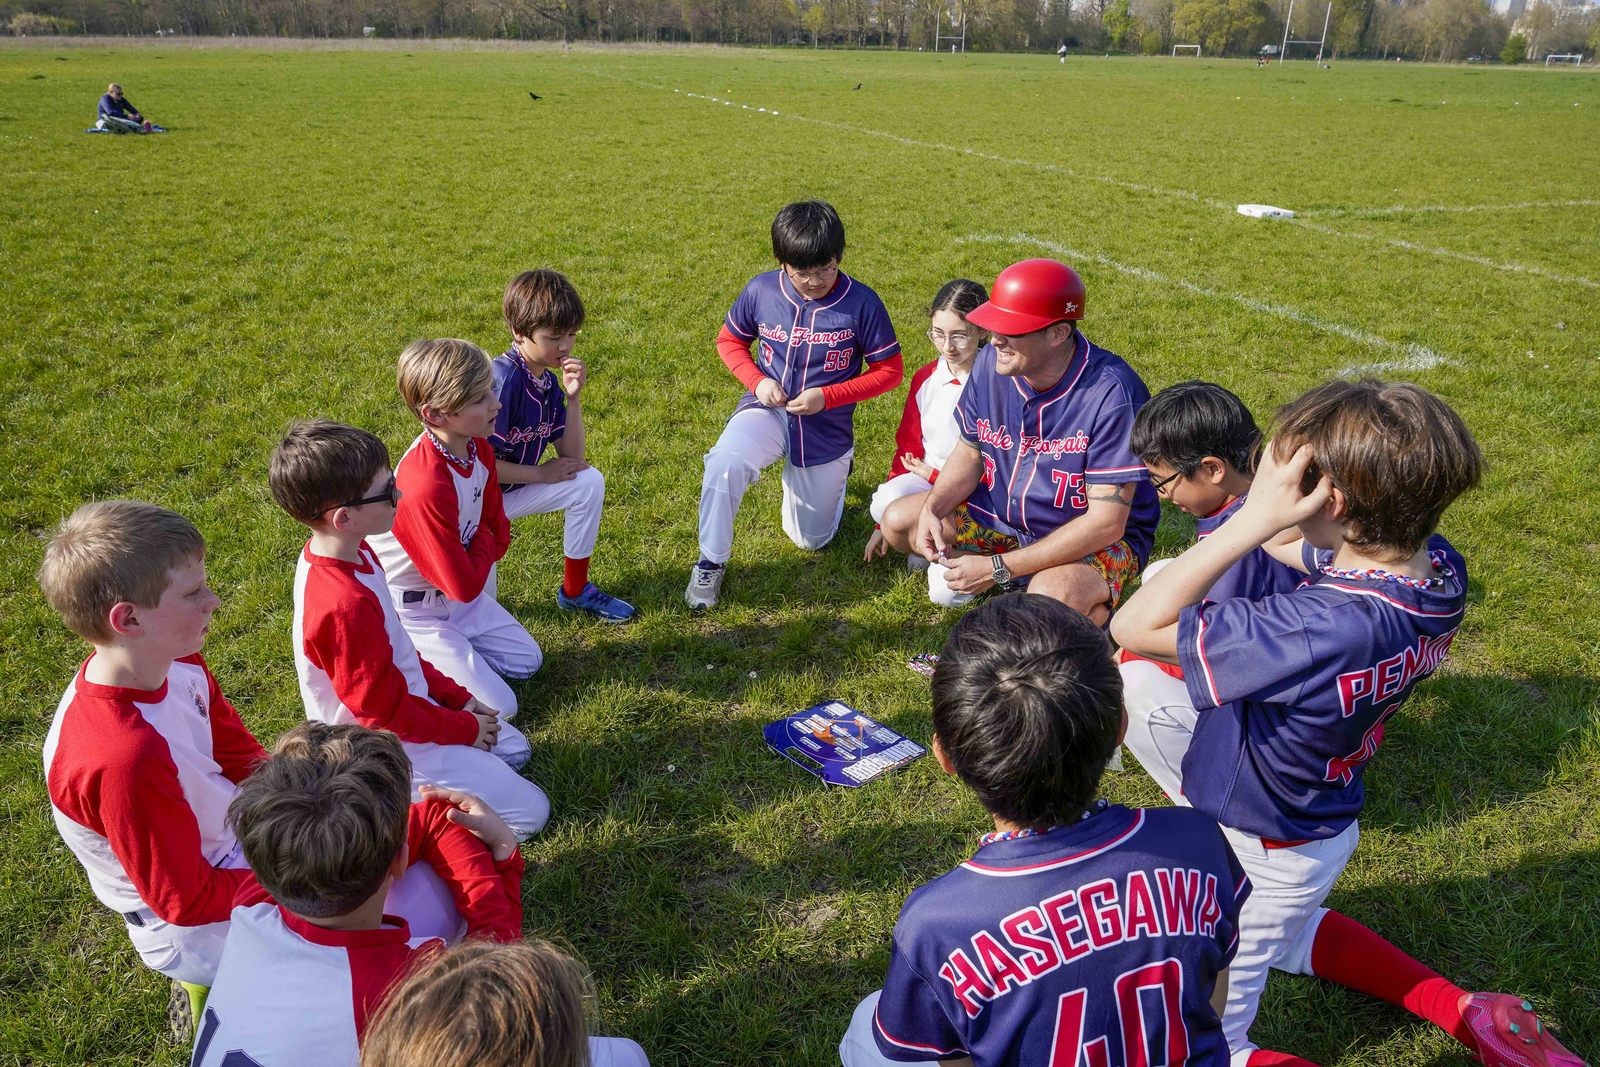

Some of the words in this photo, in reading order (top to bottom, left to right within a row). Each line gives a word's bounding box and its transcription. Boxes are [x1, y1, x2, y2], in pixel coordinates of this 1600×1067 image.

[790, 327, 855, 347] Françai
[823, 348, 854, 372] 93
[1051, 468, 1090, 509] 73
[938, 867, 1222, 1020] HASEGAWA
